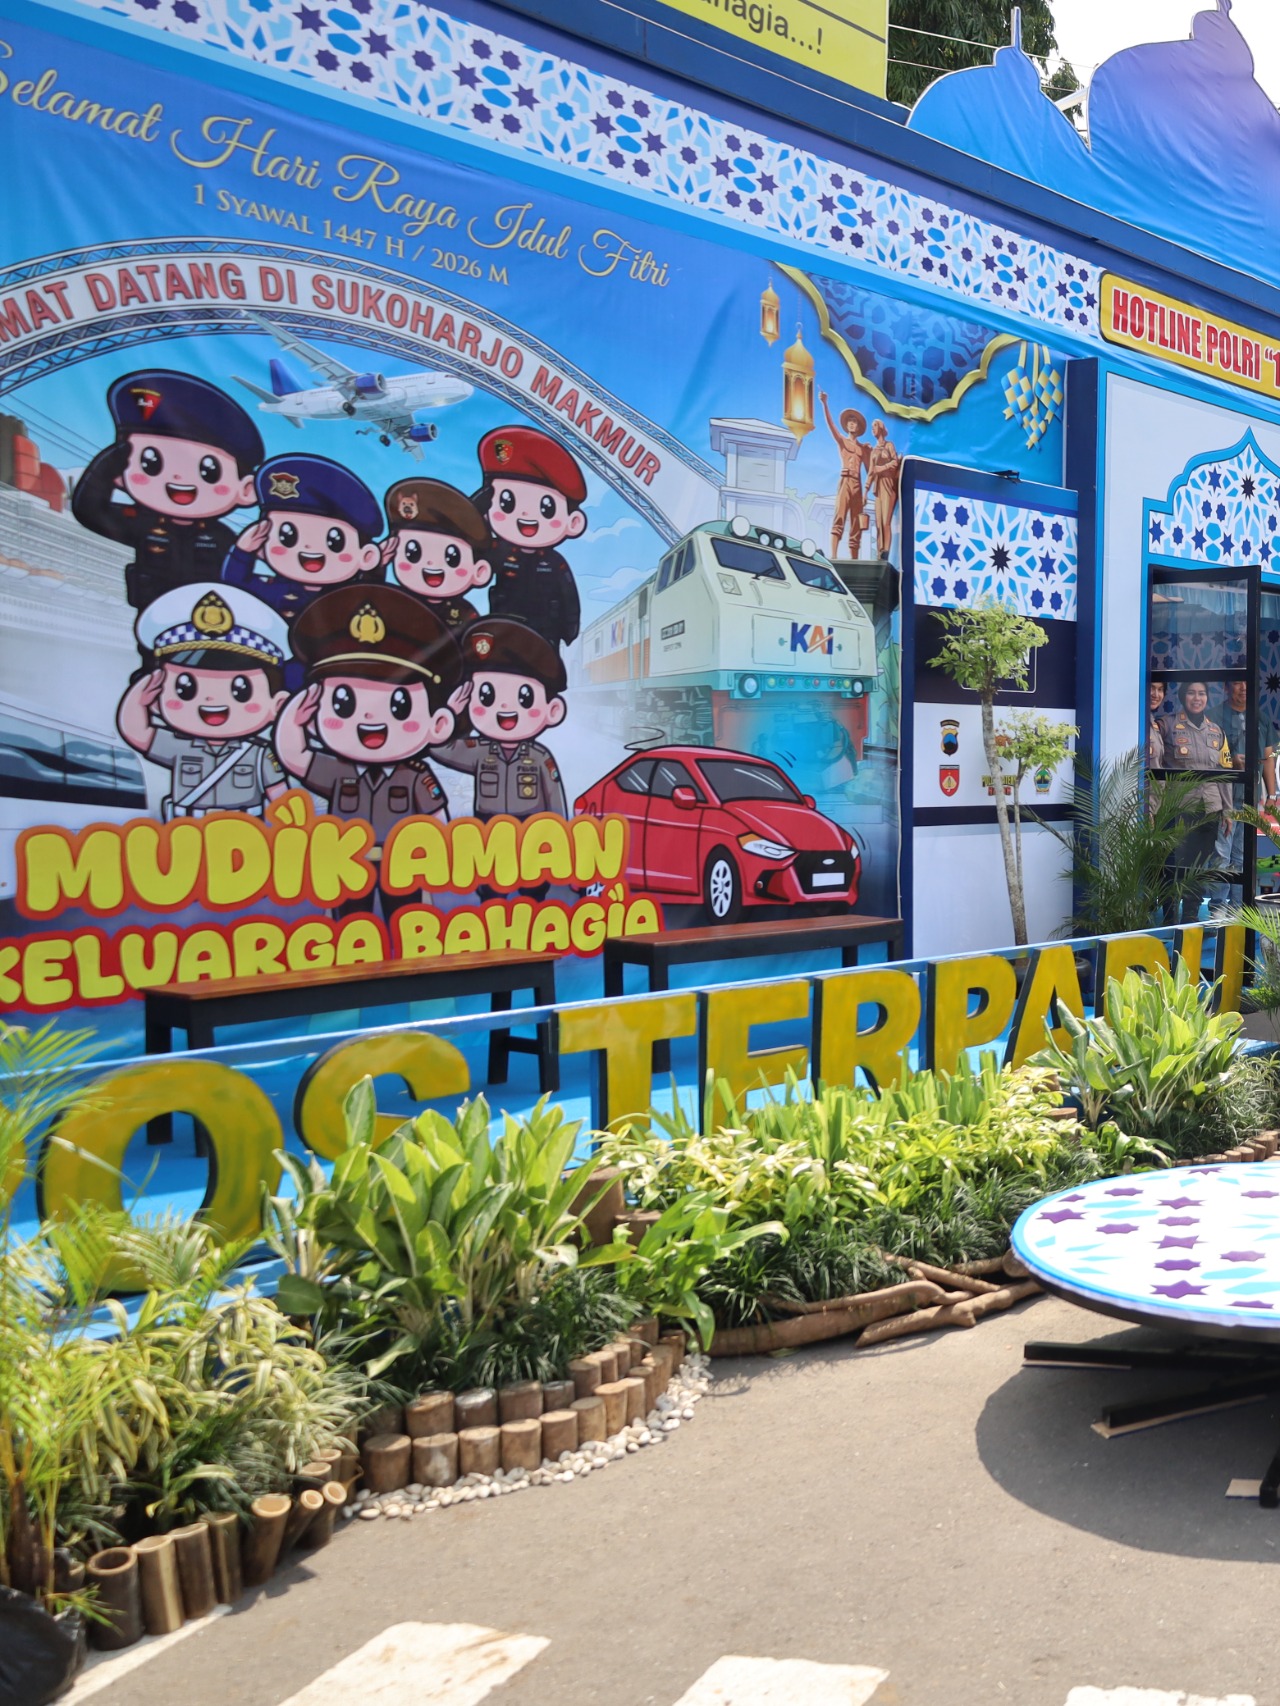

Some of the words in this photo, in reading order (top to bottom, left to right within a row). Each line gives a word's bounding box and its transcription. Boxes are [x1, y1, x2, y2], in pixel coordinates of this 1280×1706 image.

[170, 115, 322, 190] Hari
[332, 154, 459, 238] Raya
[467, 202, 572, 260] Idul
[578, 228, 671, 288] Fitri
[194, 184, 205, 206] 1
[216, 189, 314, 236] SYAWAL
[322, 219, 377, 251] 1447
[384, 235, 405, 260] H
[412, 245, 425, 263] /
[430, 247, 482, 279] 2026
[488, 263, 510, 287] M
[85, 262, 247, 312] DATANG
[259, 265, 298, 305] DI
[311, 273, 524, 380] SUKOHARJO
[530, 366, 662, 486] MAKMUR
[1111, 286, 1204, 361] HOTLINE
[1204, 322, 1262, 383] POLRI
[790, 621, 835, 656] KAI
[22, 795, 374, 915] MUDIK
[388, 815, 626, 890] AMAN
[397, 884, 661, 960] BAHAGIA
[0, 1055, 471, 1292] OS
